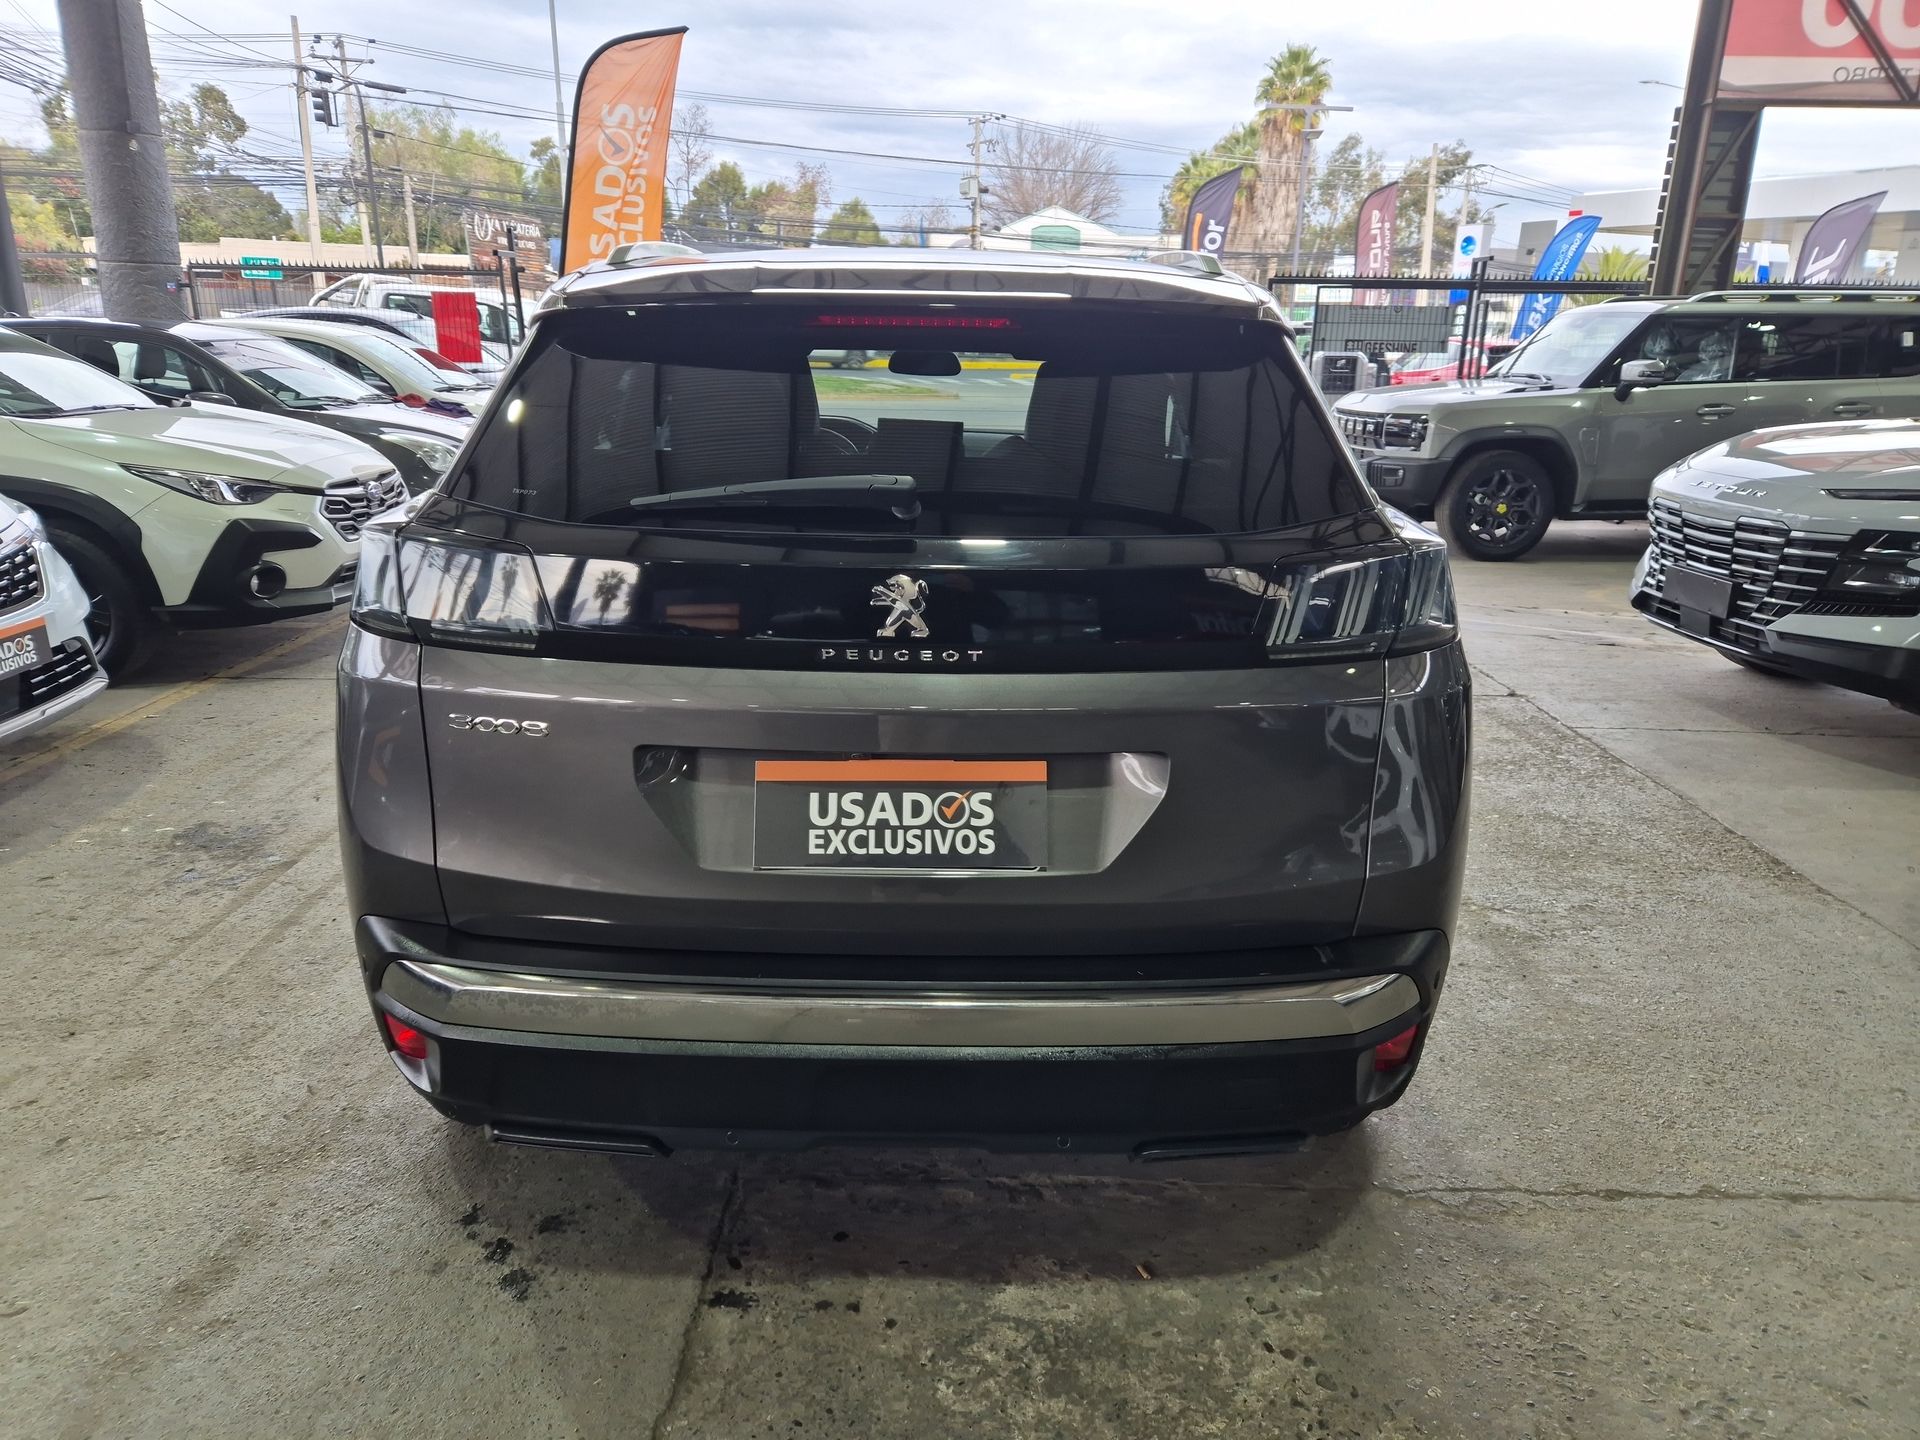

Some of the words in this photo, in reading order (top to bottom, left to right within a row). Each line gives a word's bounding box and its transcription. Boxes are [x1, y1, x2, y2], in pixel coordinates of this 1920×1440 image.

[588, 103, 636, 263] SADOS
[1690, 480, 1768, 498] JETOUR
[820, 648, 984, 662] PEUGEOT
[448, 713, 550, 737] 3008
[808, 790, 995, 829] USADOS
[808, 829, 997, 856] EXCLUSIVOS
